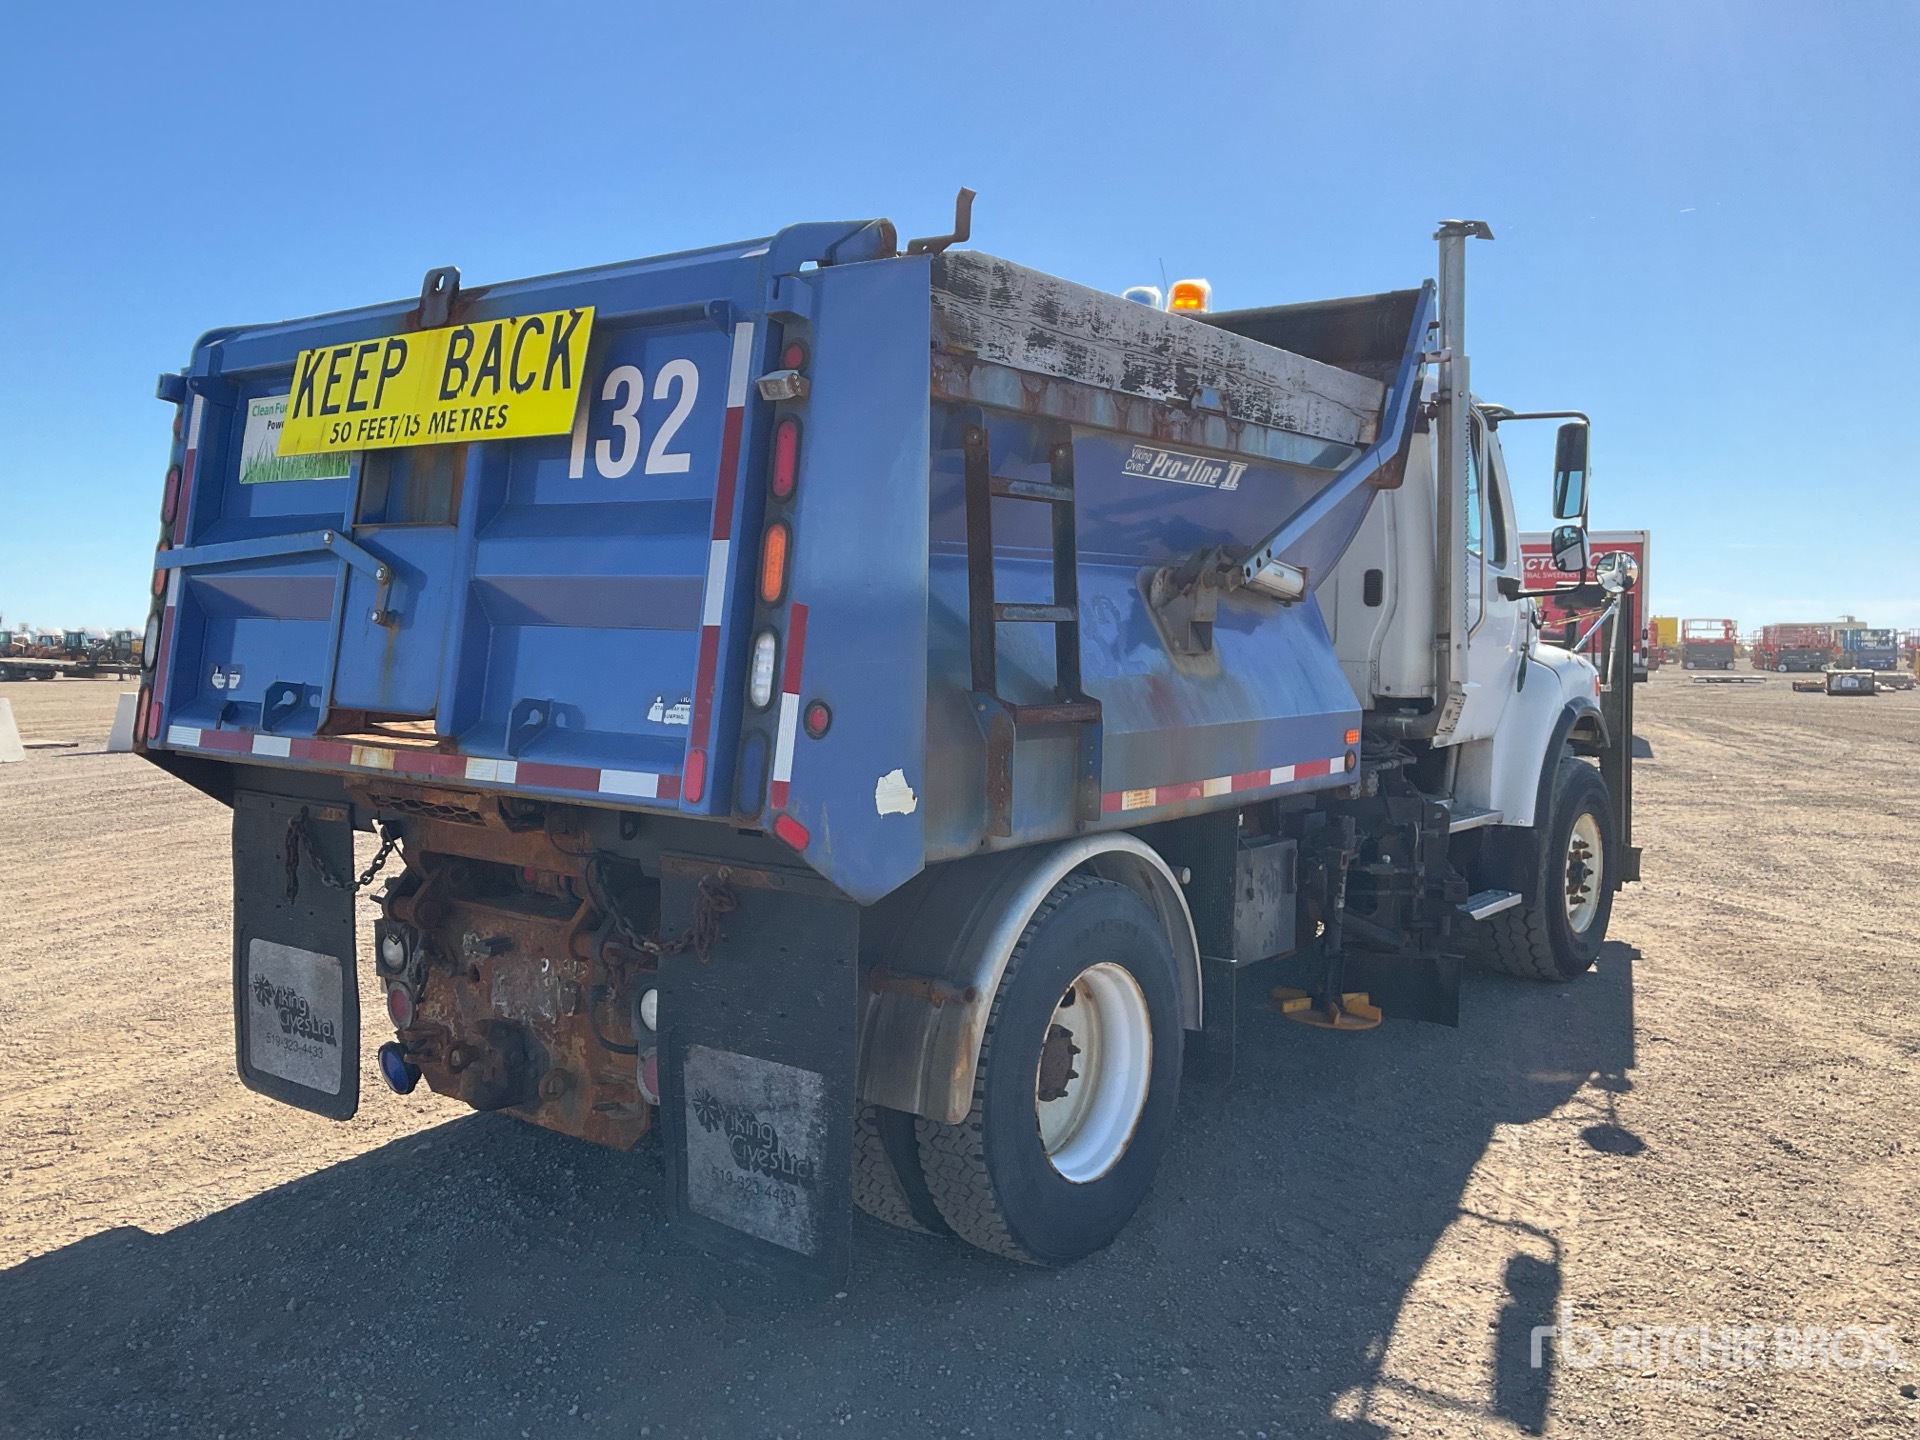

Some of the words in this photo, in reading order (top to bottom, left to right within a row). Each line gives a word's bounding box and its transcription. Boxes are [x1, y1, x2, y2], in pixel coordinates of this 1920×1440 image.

[293, 338, 408, 419] KEEP
[439, 309, 582, 401] BACK
[252, 404, 274, 417] Clean
[275, 402, 288, 414] Fue
[267, 420, 284, 431] Pow
[329, 421, 352, 444] 50
[356, 413, 421, 444] FEET/15
[428, 404, 509, 434] METRES
[1125, 459, 1145, 472] Cives
[1131, 448, 1153, 464] Viking
[1148, 452, 1222, 485] Pro-line
[1524, 571, 1541, 579] TRIAL
[271, 983, 308, 1016] Viking
[278, 1006, 312, 1033] Cives
[265, 1032, 323, 1059] 519-323-4433
